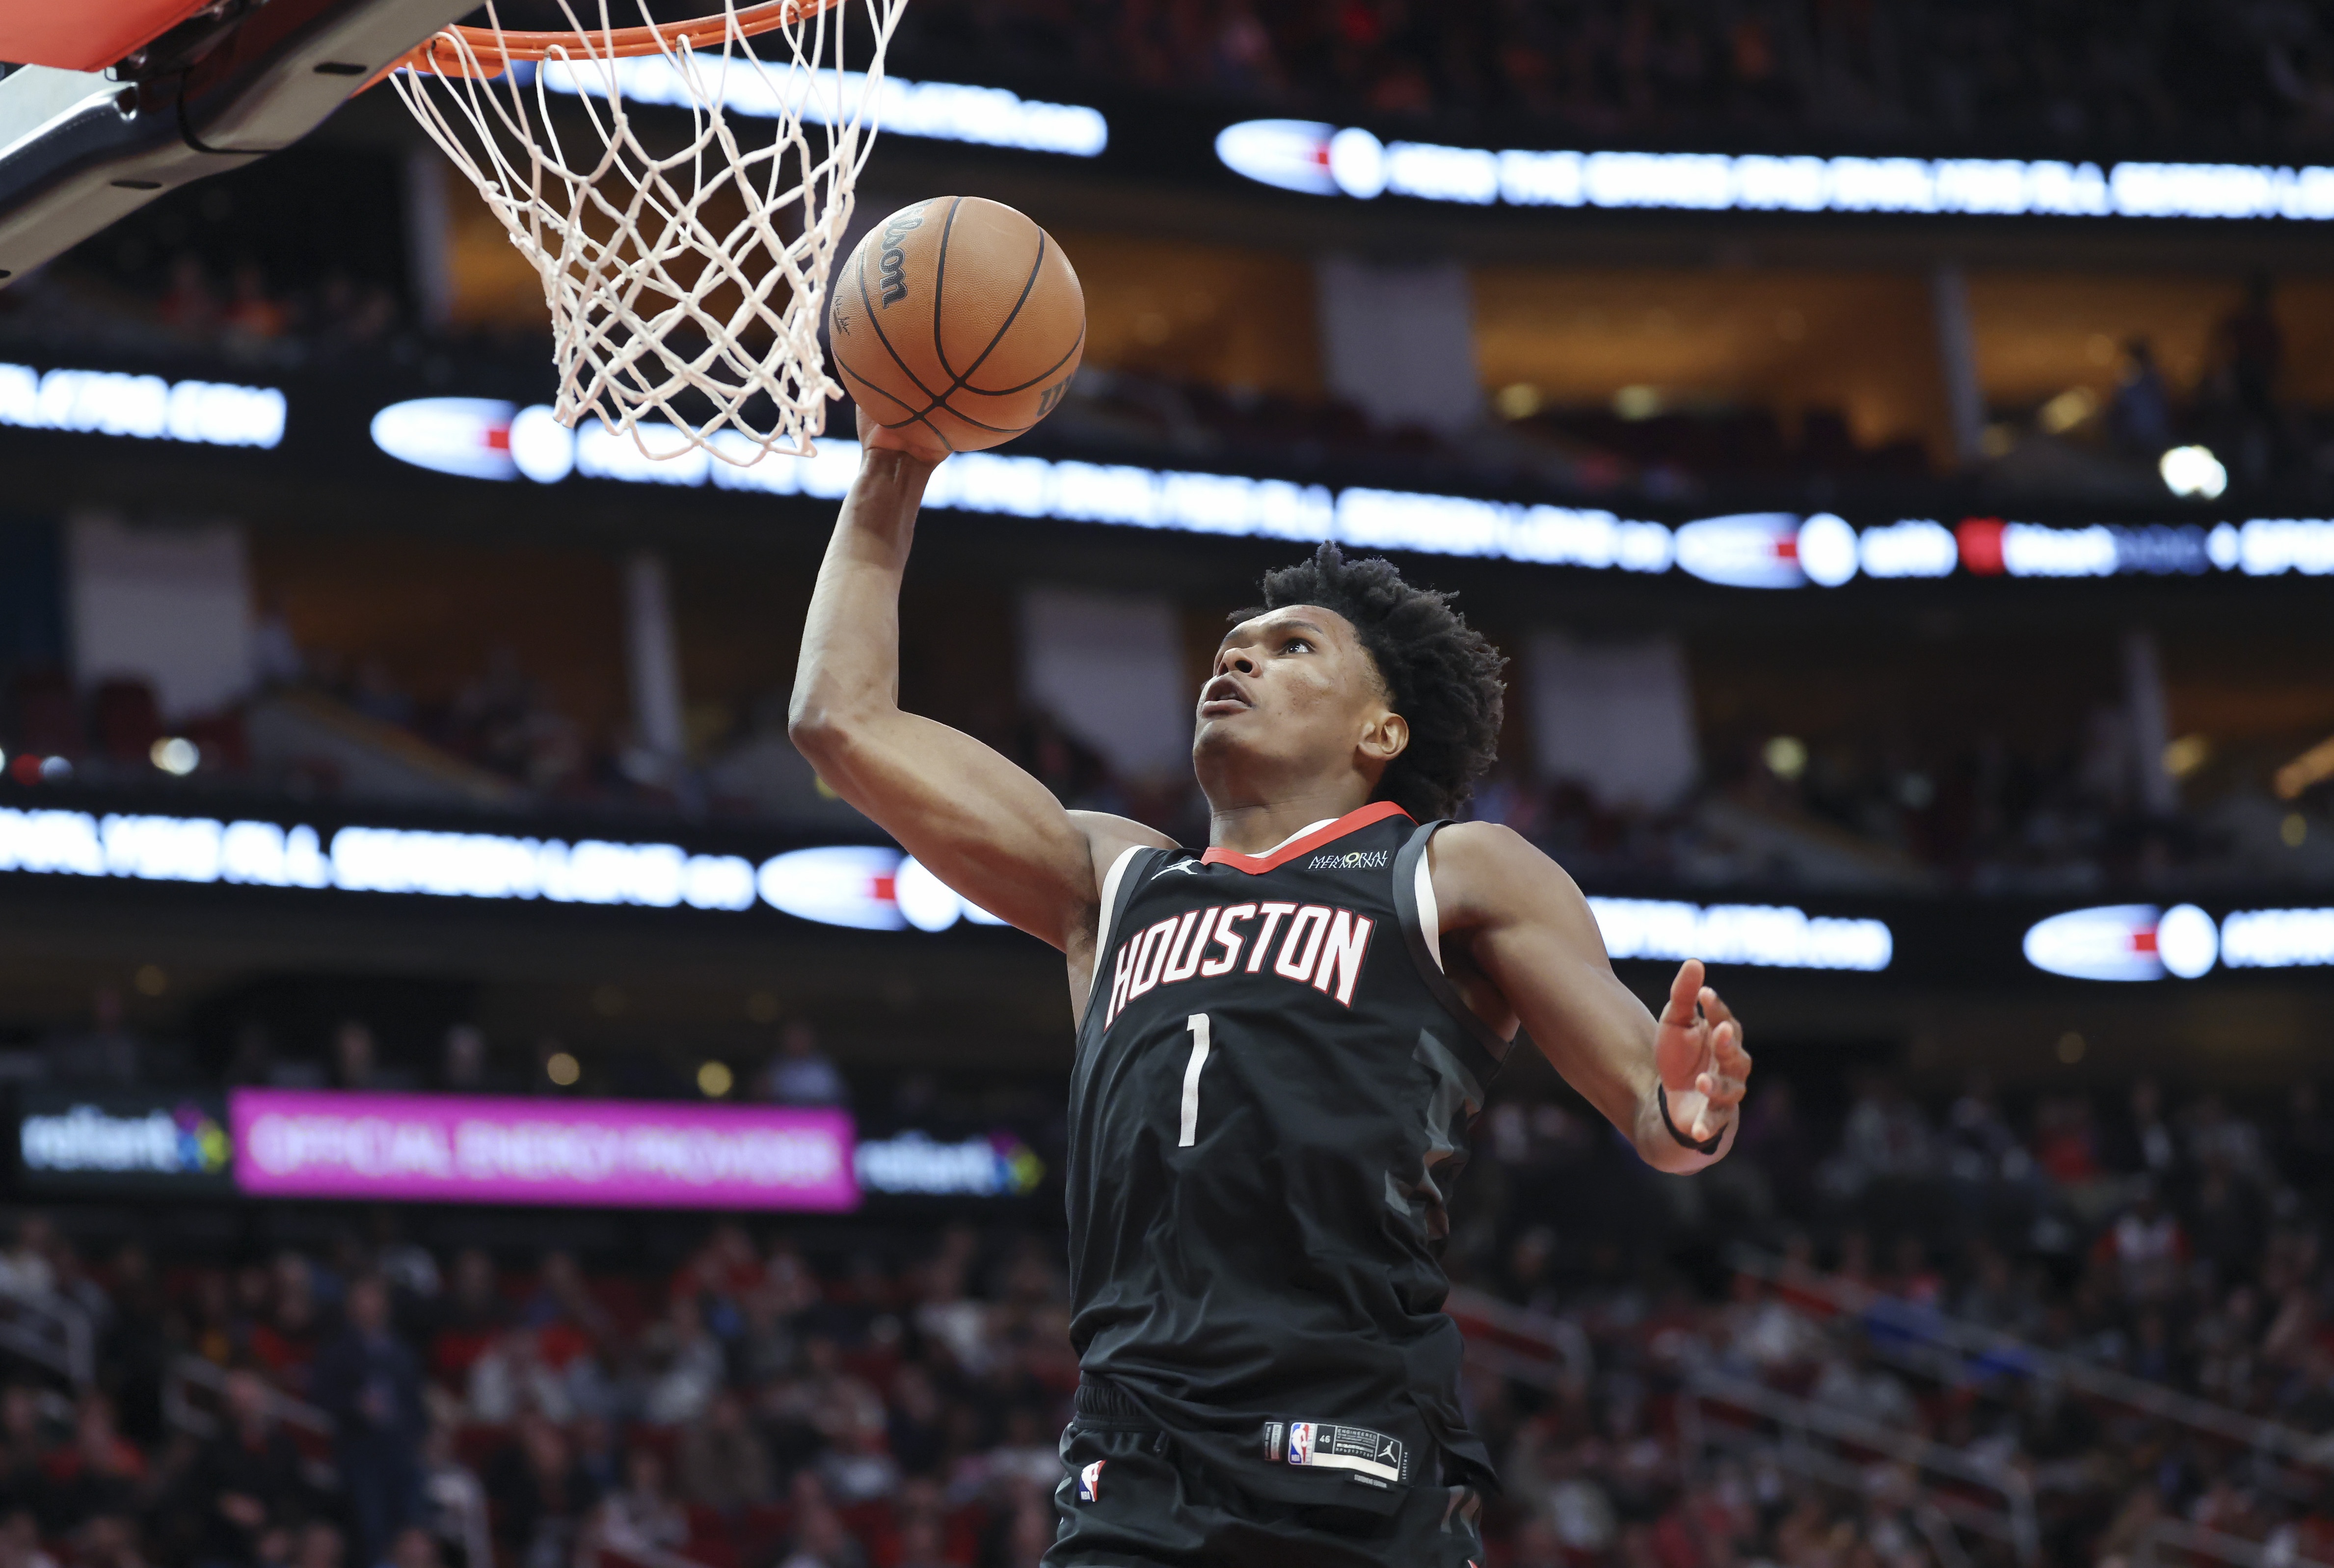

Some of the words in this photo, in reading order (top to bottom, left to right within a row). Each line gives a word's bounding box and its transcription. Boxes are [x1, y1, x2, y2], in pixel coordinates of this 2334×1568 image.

[1312, 850, 1388, 863] MEMORIAL
[1308, 858, 1387, 869] HERMANN
[1103, 902, 1374, 1034] HOUSTON
[1178, 1012, 1210, 1147] 1
[1319, 1435, 1331, 1443] 46
[1080, 1491, 1091, 1500] NBA
